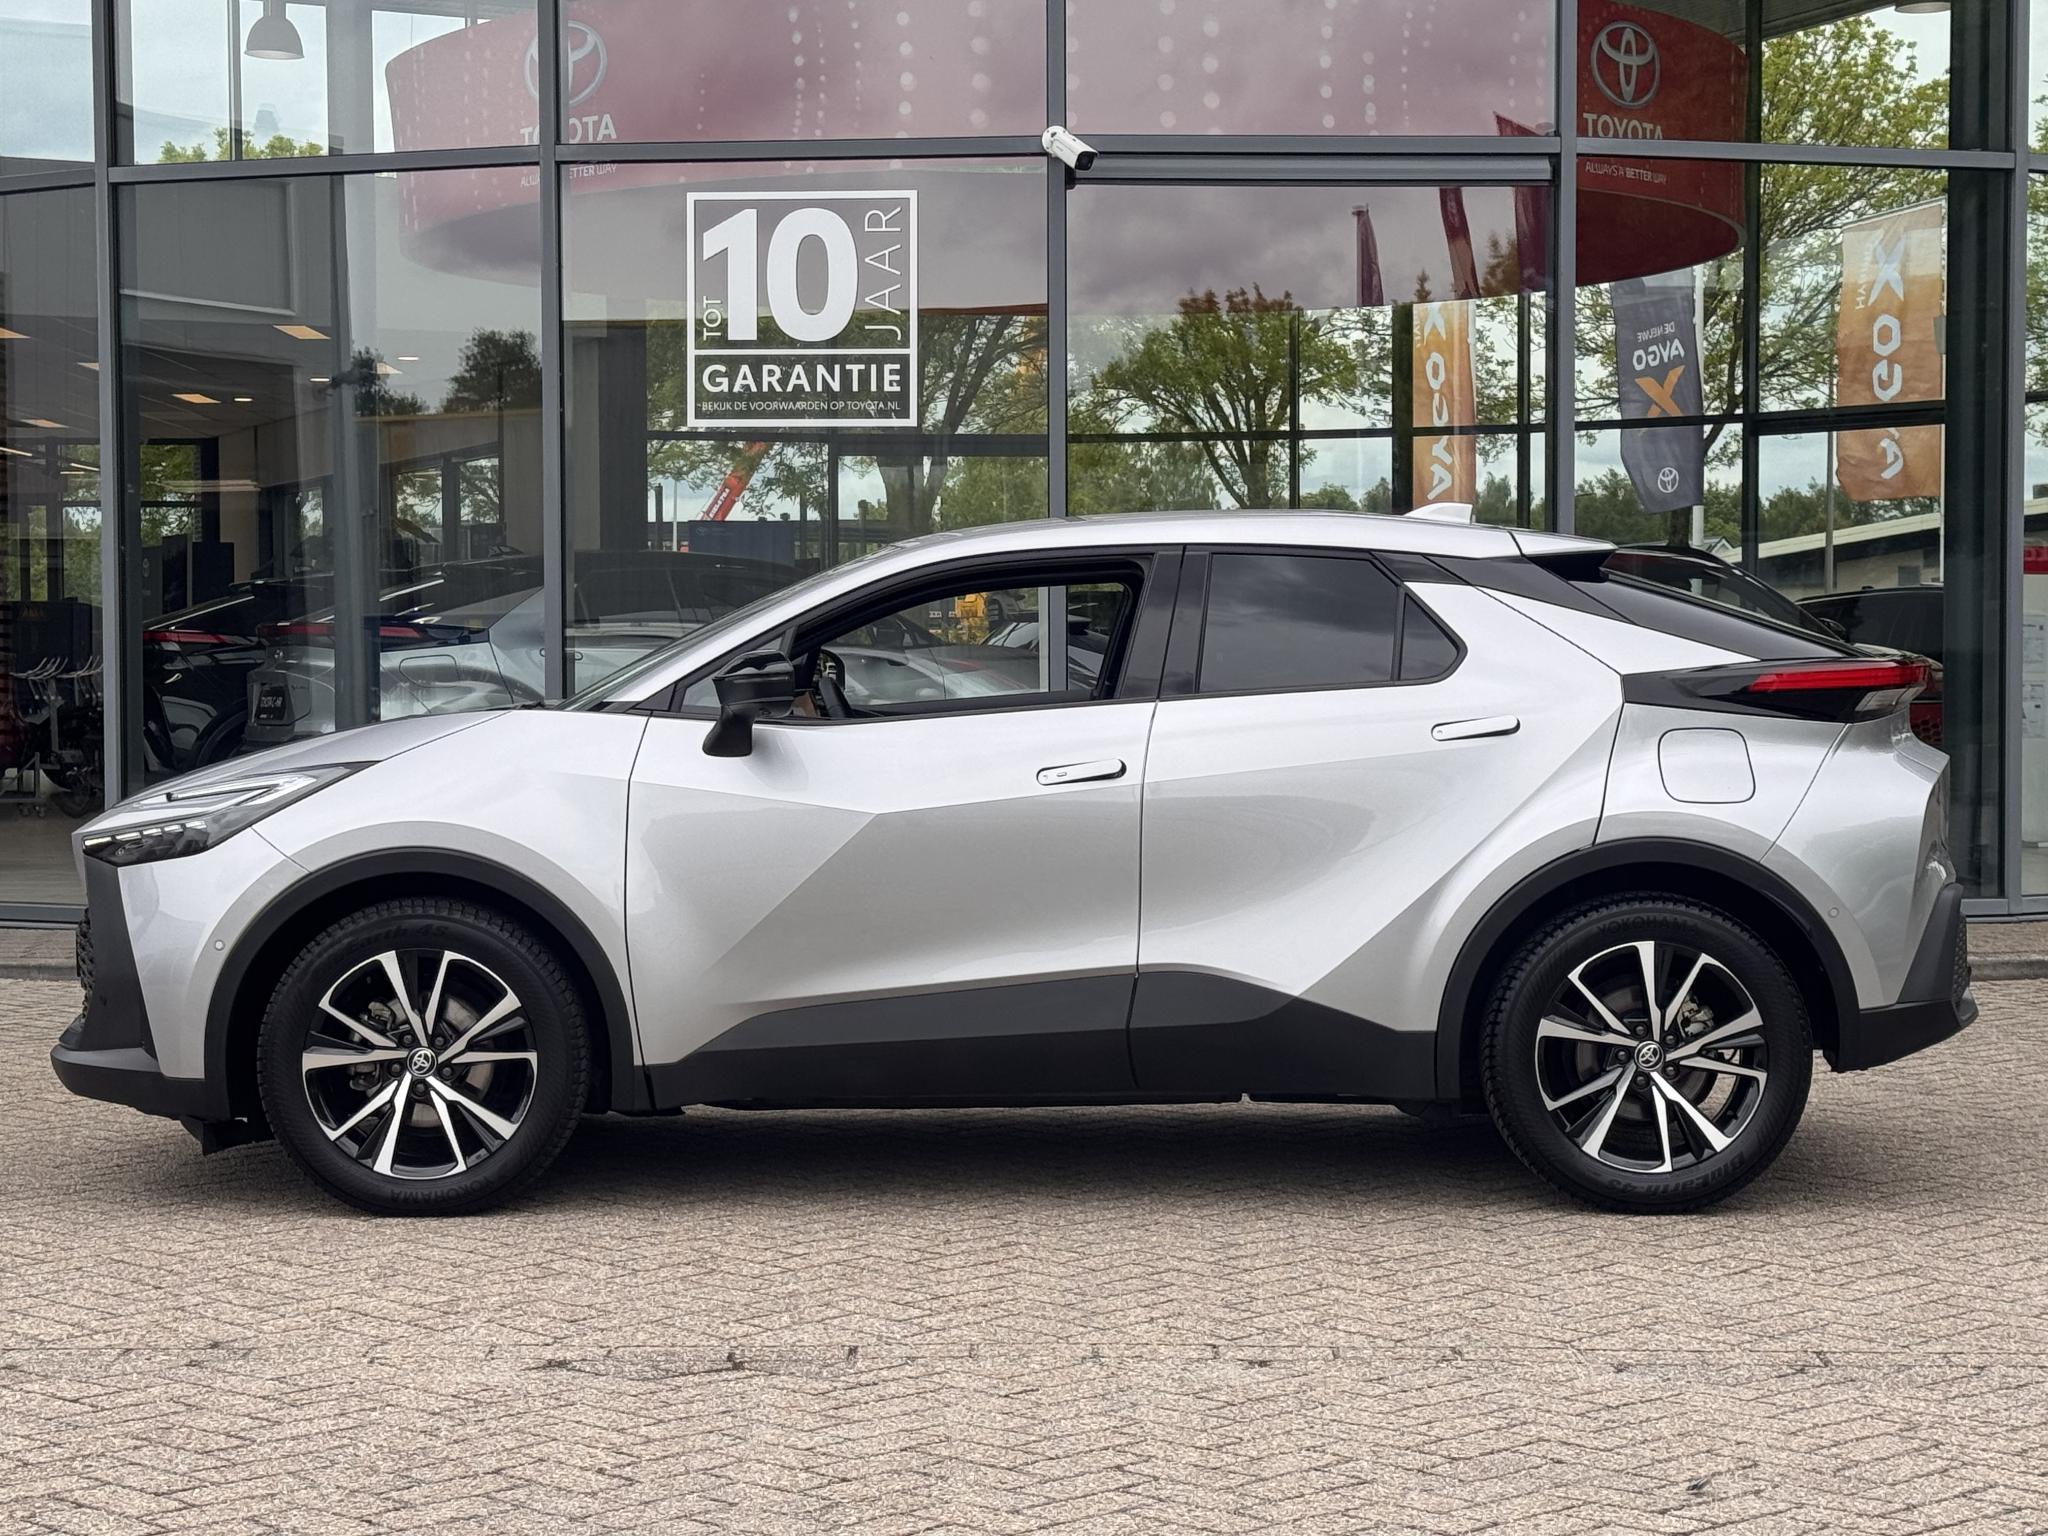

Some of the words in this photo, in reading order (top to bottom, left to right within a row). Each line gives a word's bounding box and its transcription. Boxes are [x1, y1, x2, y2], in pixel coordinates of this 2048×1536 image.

[520, 114, 617, 145] TOTA
[1583, 112, 1663, 139] TOYOTA
[1585, 161, 1618, 177] ALWAYS
[1625, 167, 1652, 182] BETTER
[703, 207, 859, 342] 10
[864, 206, 902, 341] JAAR
[703, 295, 722, 341] TOT
[702, 364, 901, 393] GARANTIE
[702, 401, 732, 411] BEKIJK
[734, 401, 747, 411] DE
[749, 401, 828, 411] VOORWAARDEN
[830, 401, 845, 411] OP
[847, 401, 901, 411] TOYOTA.NL
[390, 1176, 496, 1203] YOKOHAMA
